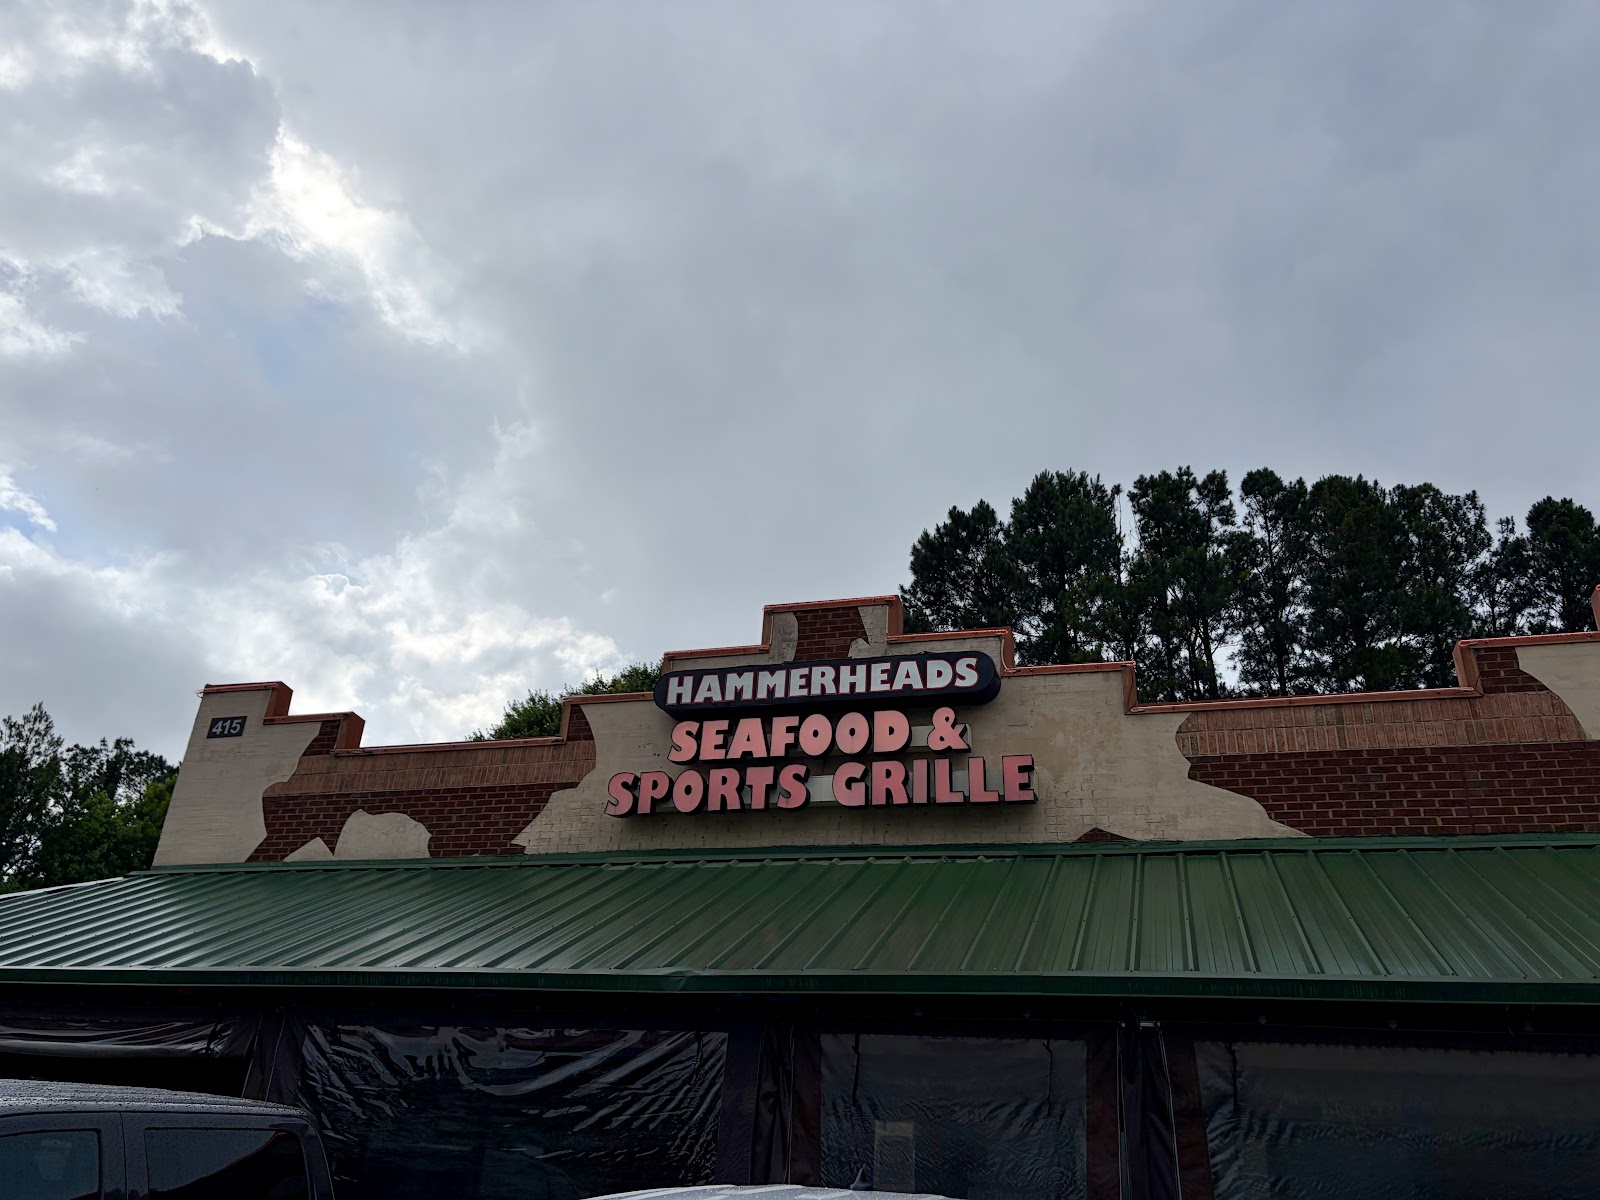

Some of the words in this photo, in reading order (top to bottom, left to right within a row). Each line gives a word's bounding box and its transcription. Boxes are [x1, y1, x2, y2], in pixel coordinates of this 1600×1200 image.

[666, 657, 979, 706] HAMMERHEADS
[211, 719, 242, 735] 415
[667, 709, 912, 764] SEAFOOD
[926, 706, 970, 753] &
[604, 763, 811, 818] SPORTS
[831, 754, 1037, 808] GRILLE
